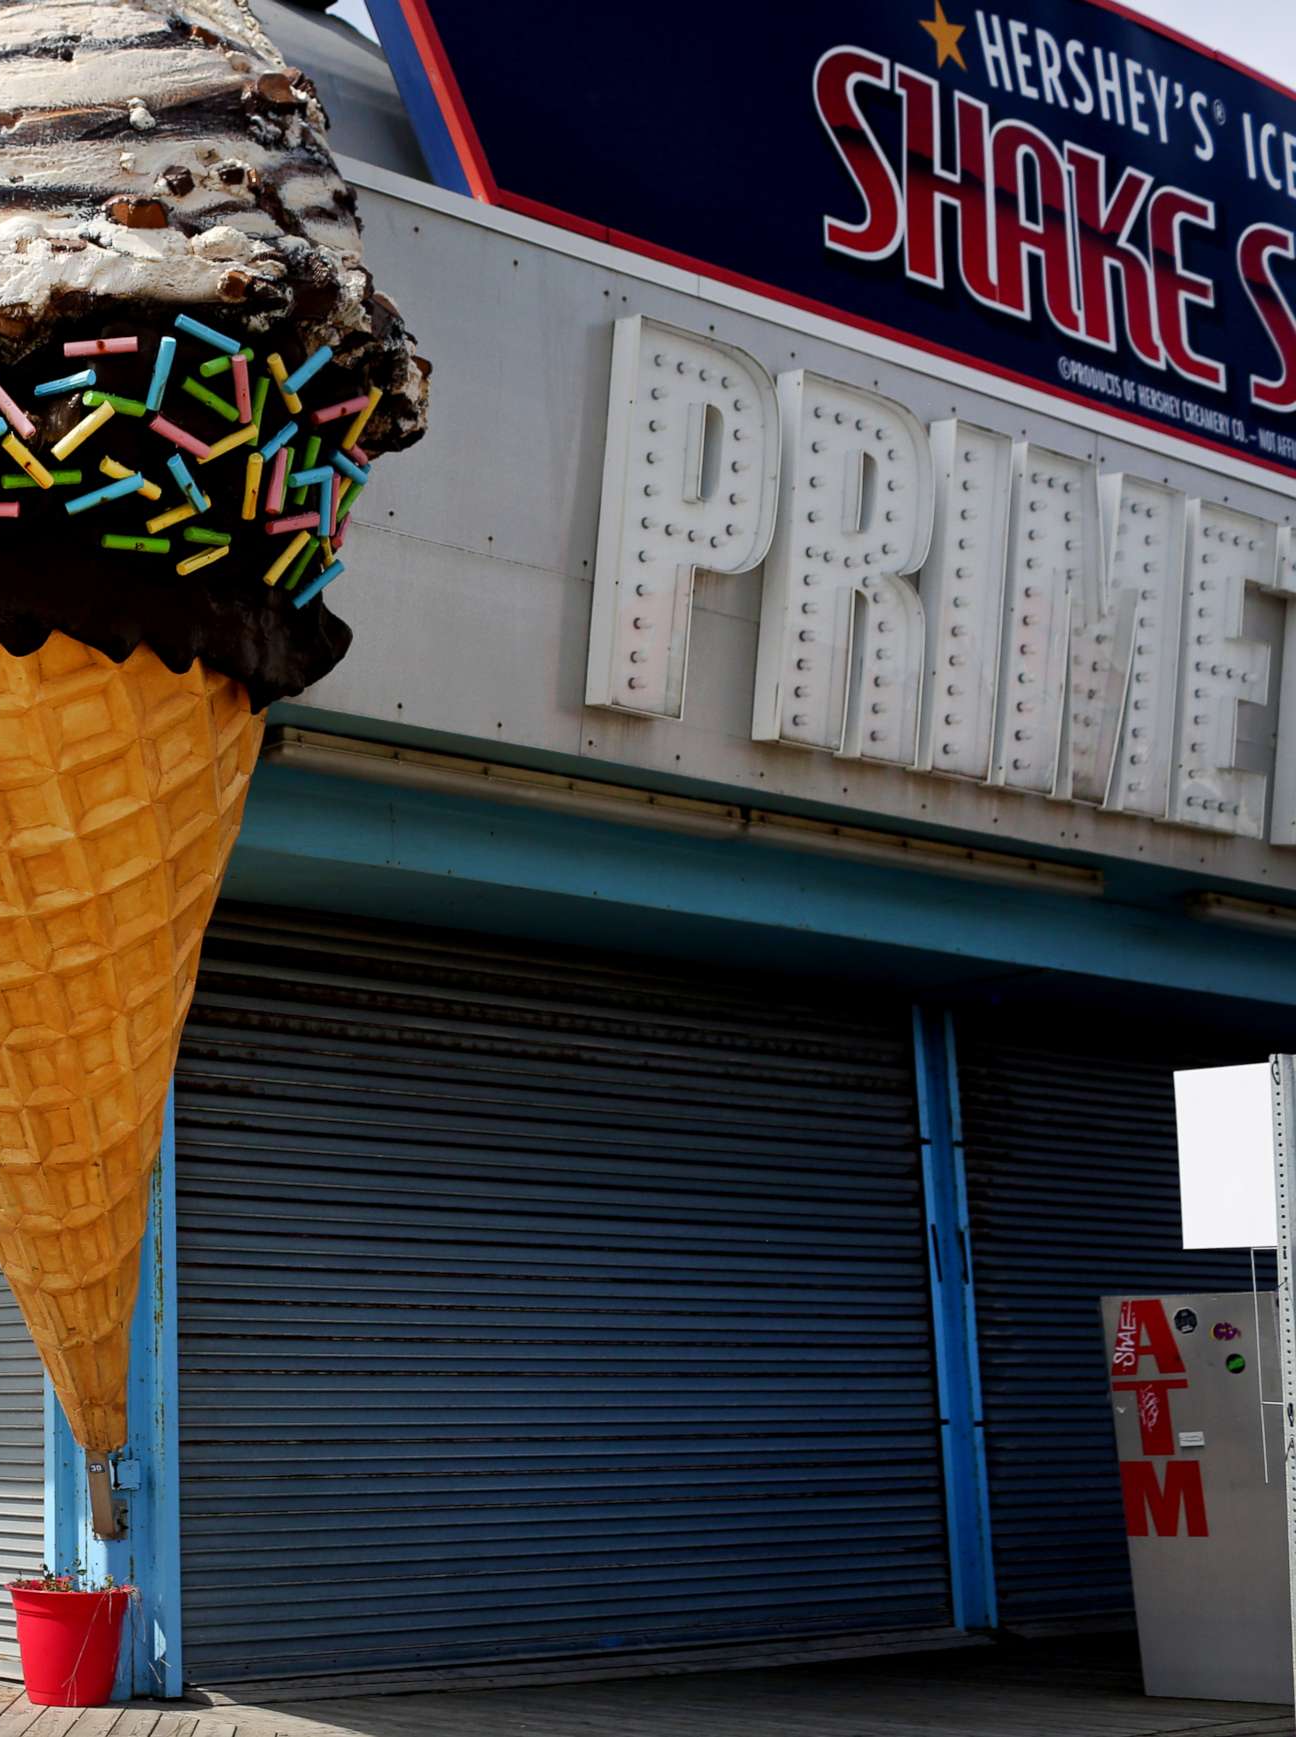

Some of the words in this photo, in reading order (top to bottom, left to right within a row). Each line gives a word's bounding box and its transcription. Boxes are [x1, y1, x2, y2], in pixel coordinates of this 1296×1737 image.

[813, 44, 1226, 391] SHAKE
[1122, 378, 1136, 404] OF
[1137, 384, 1181, 420] HERSHEY
[1181, 401, 1230, 437] CREAMERY
[1257, 427, 1276, 453] NOT
[1110, 1299, 1209, 1537] ATM
